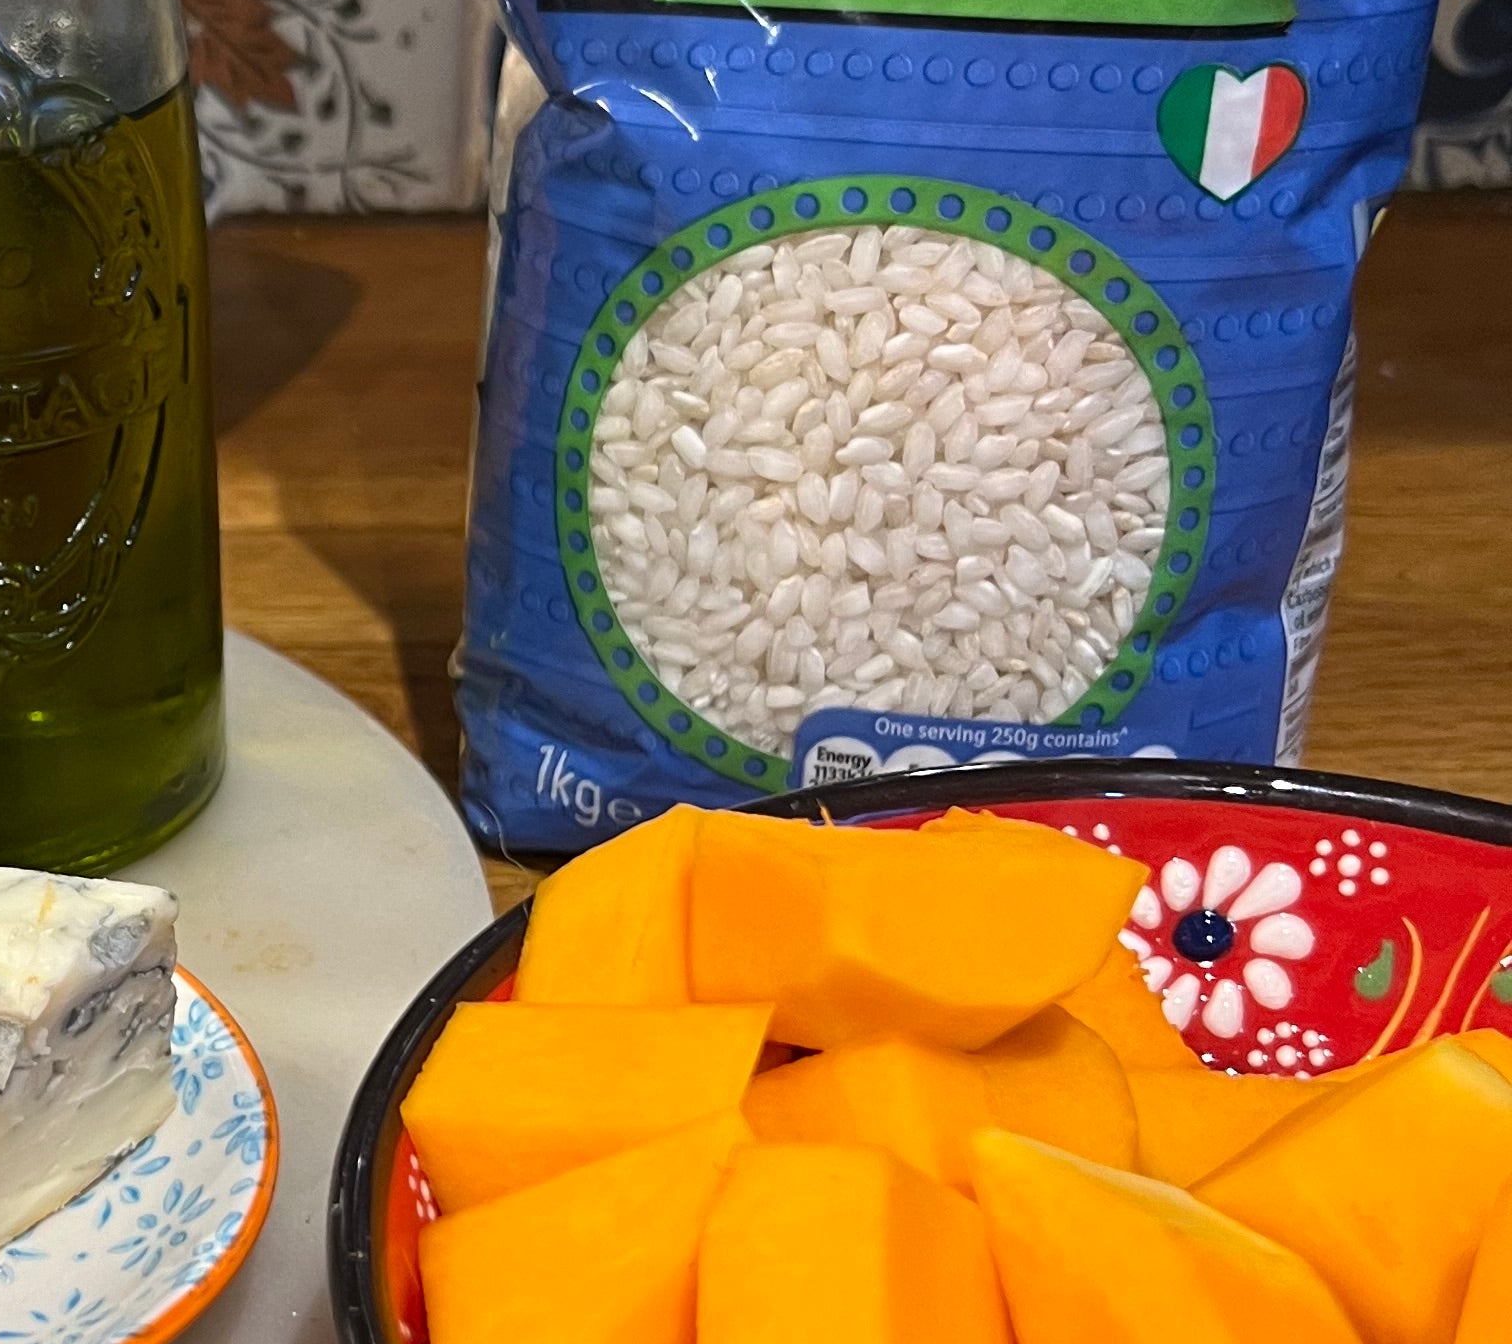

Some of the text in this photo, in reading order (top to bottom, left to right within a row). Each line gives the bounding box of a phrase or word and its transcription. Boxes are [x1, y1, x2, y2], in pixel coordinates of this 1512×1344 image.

[874, 716, 915, 738] One
[918, 722, 987, 748] serving
[991, 726, 1039, 750] 250g
[816, 745, 872, 770] Energy
